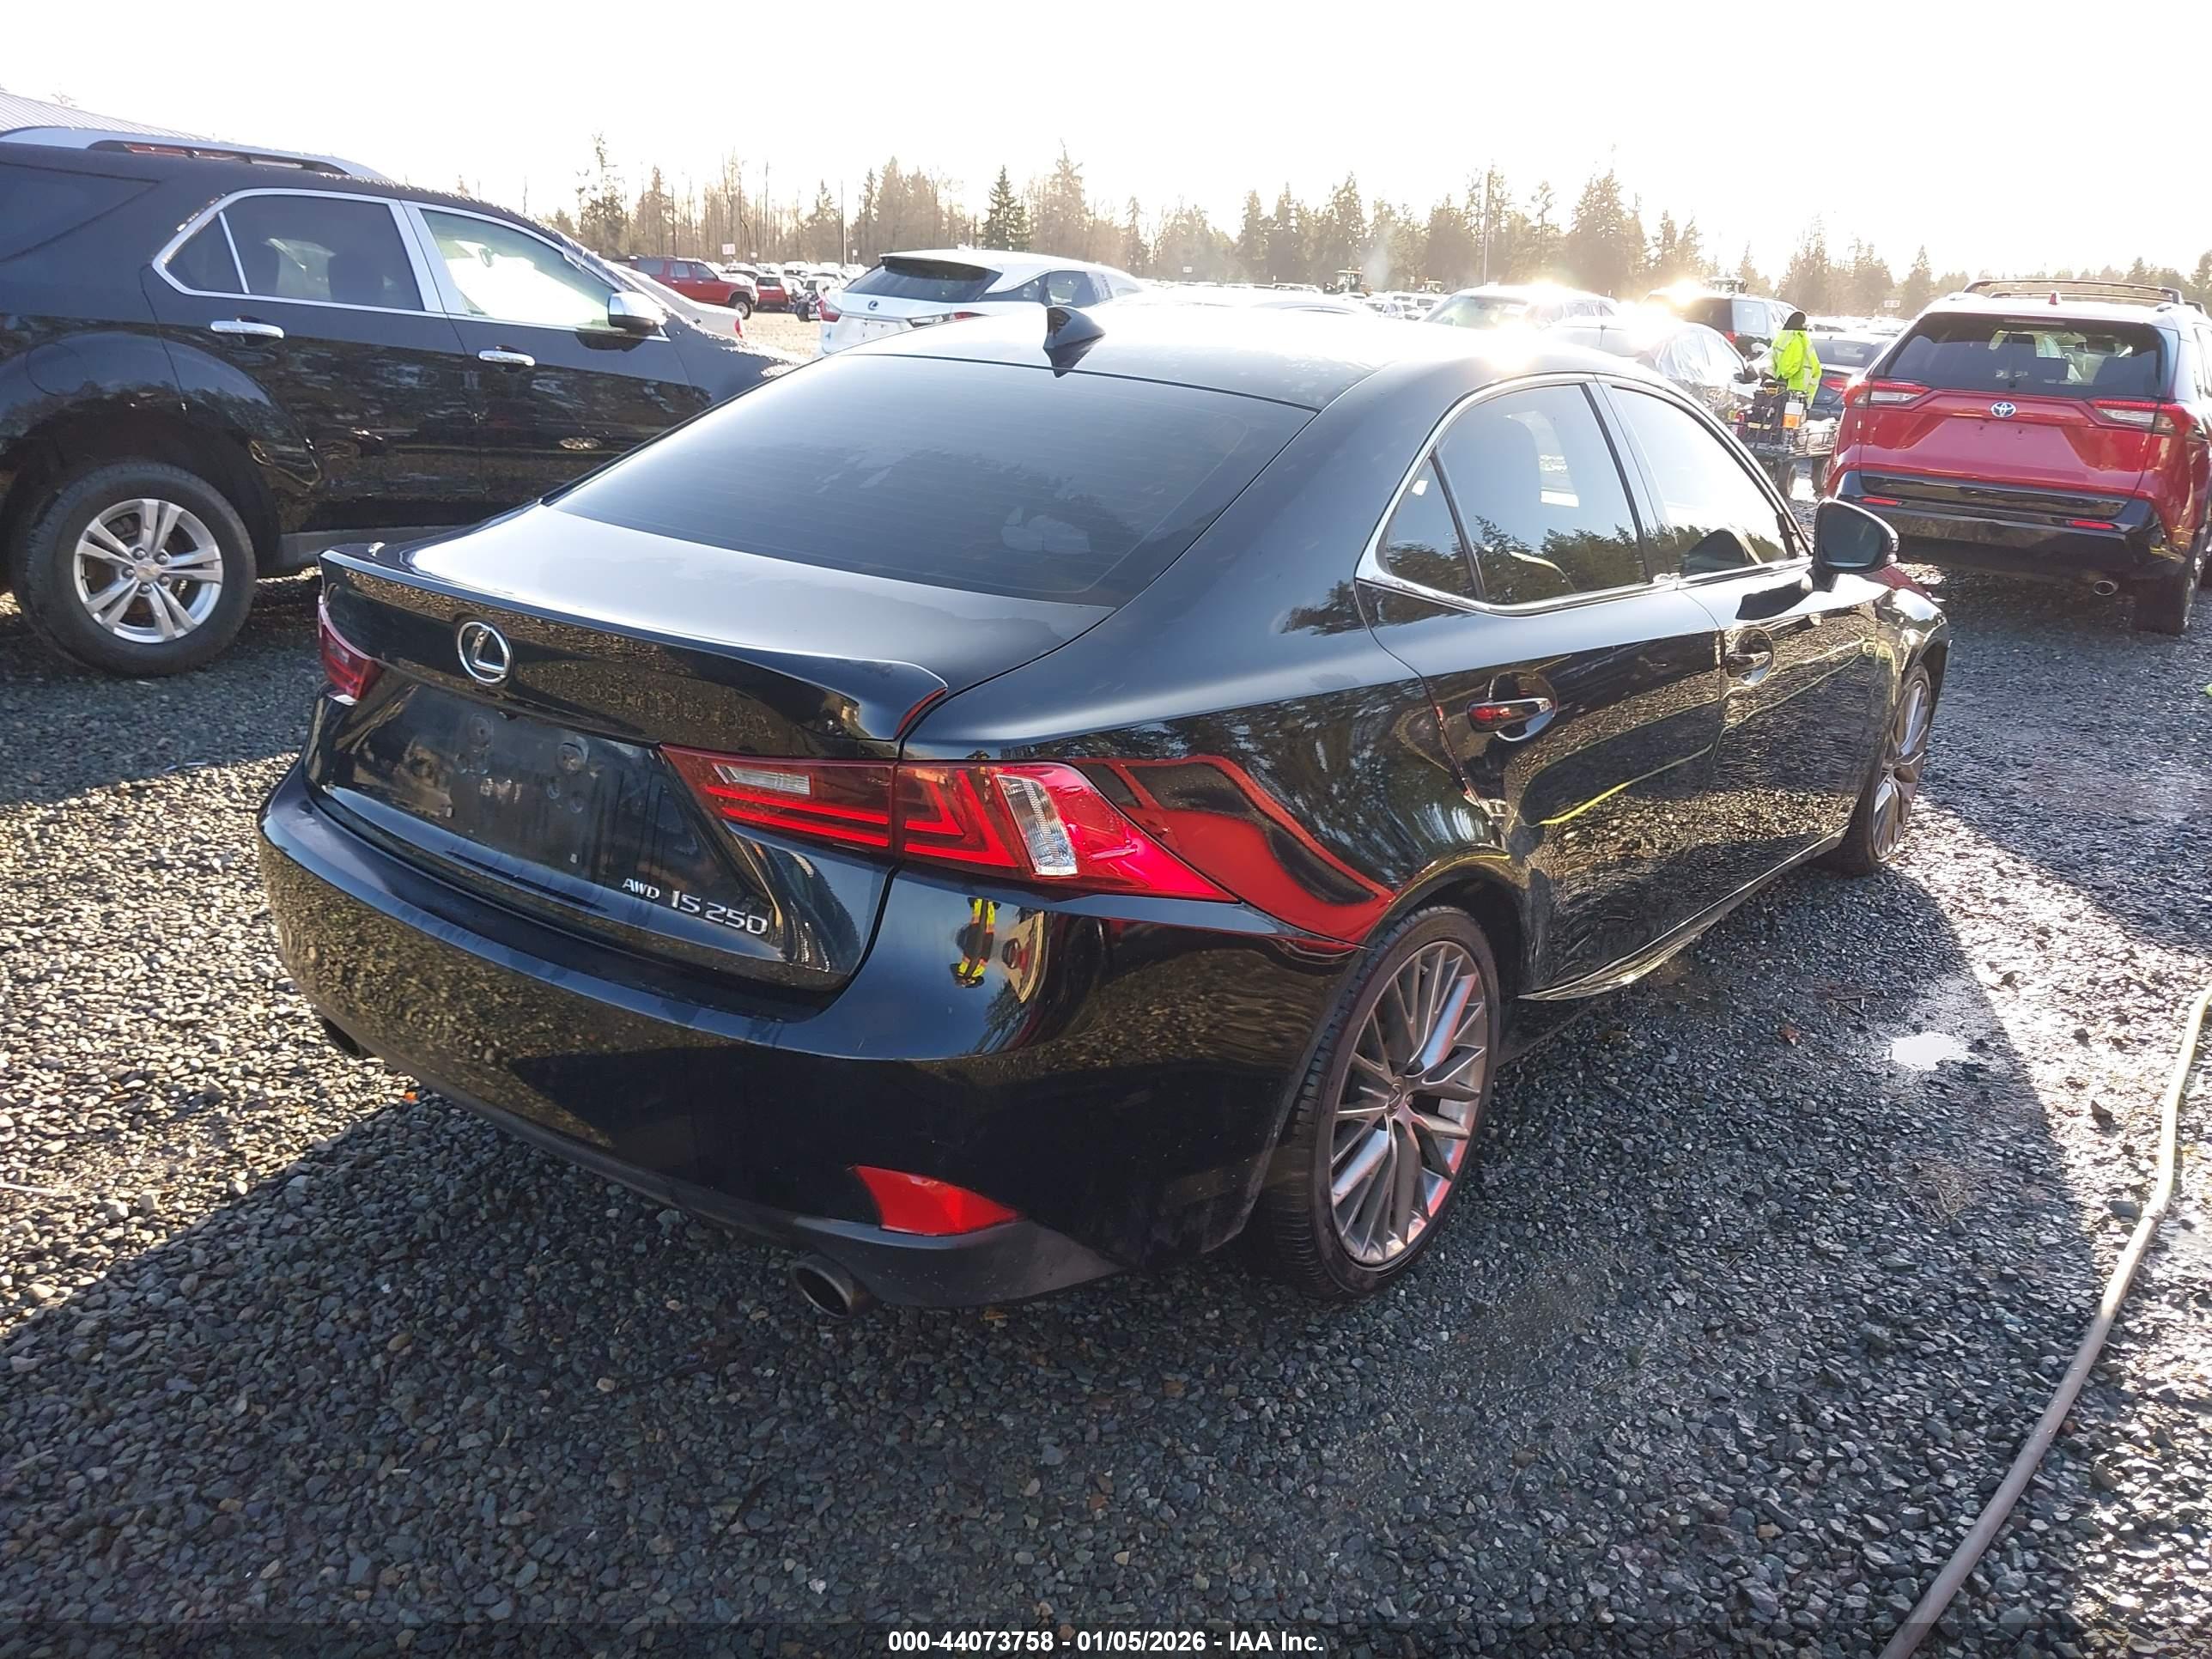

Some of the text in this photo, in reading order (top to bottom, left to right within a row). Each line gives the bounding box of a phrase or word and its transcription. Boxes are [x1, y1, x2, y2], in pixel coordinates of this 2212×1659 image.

[622, 878, 769, 935] AWD IS 250
